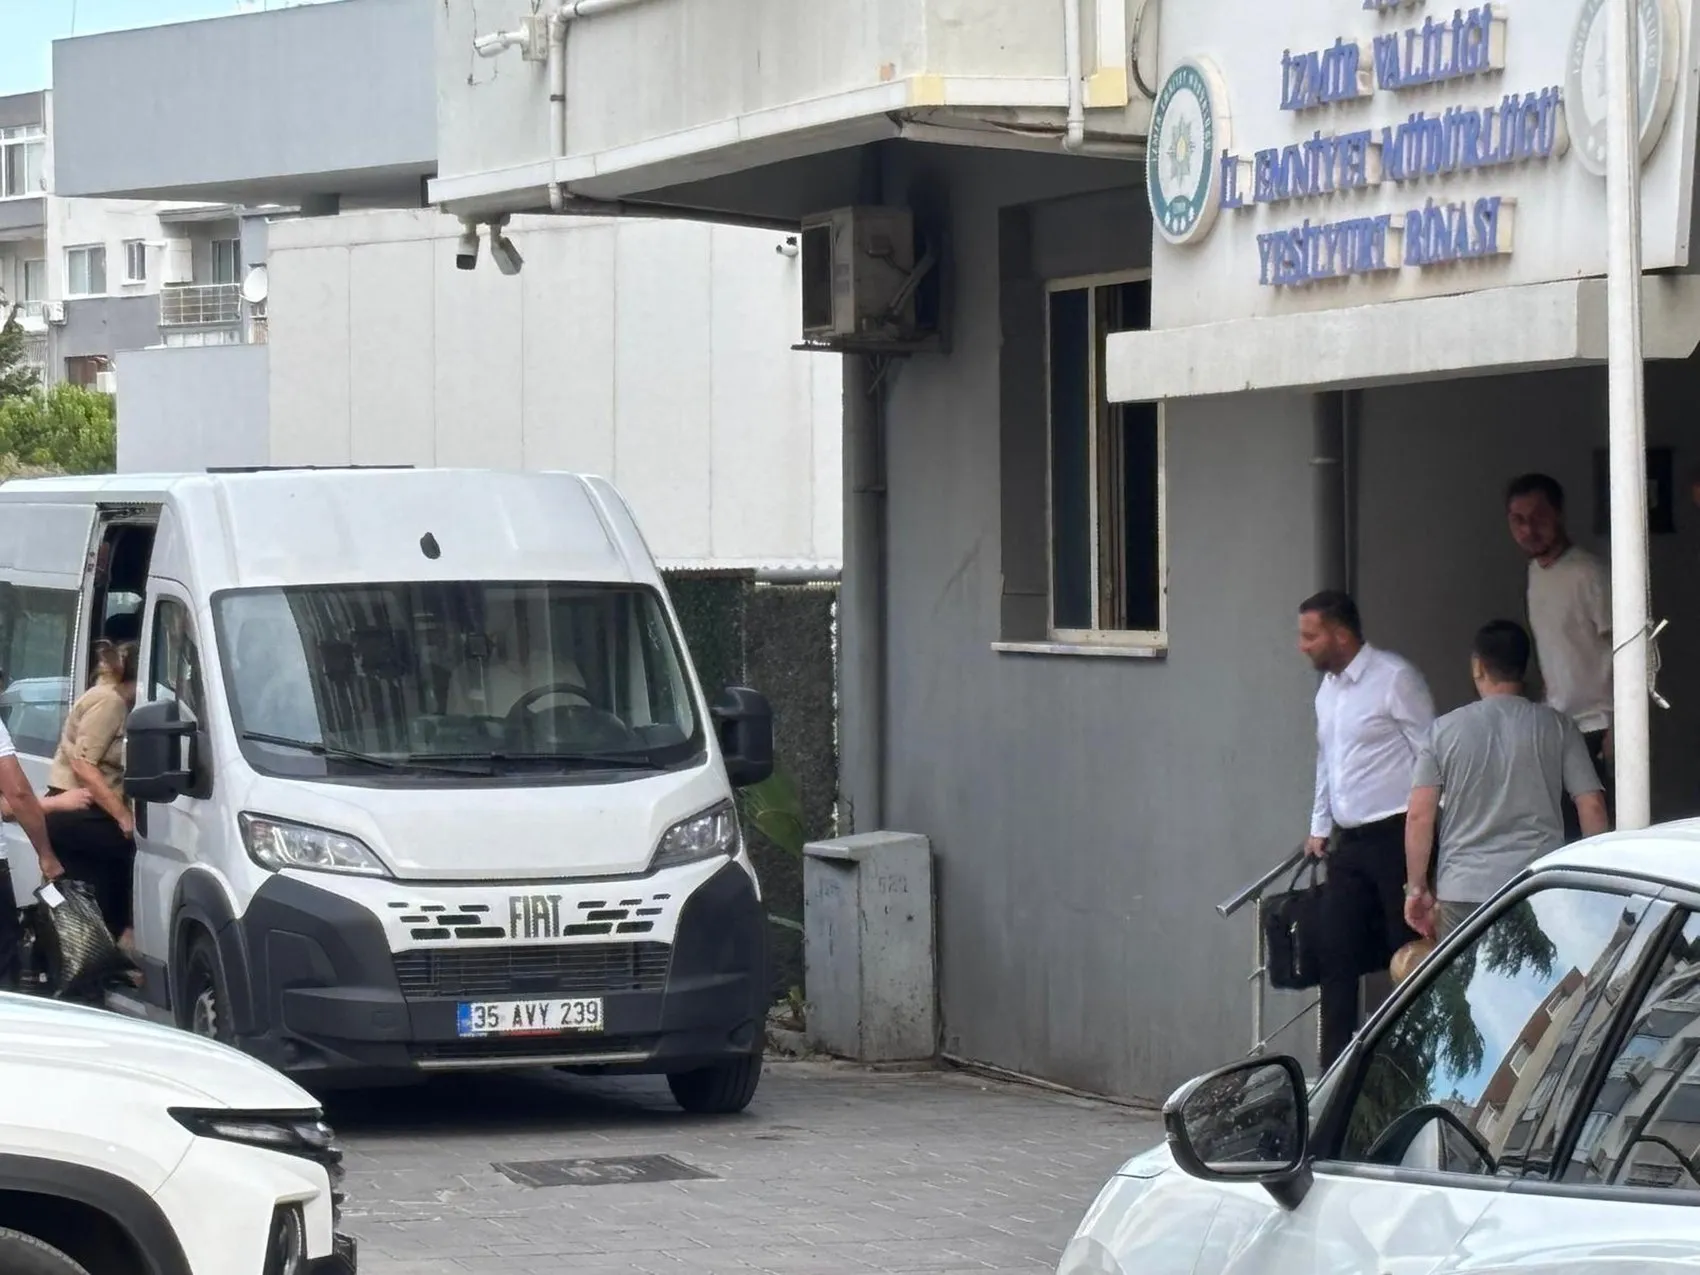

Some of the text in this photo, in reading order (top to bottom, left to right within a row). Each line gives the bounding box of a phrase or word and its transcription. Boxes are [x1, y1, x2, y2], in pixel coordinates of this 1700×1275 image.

[1280, 36, 1360, 110] İZMİR
[1253, 129, 1372, 203] EMNİYET
[1404, 196, 1502, 267] BİNASI
[509, 895, 563, 938] FIAT
[474, 1001, 599, 1029] 35 AVY 239
